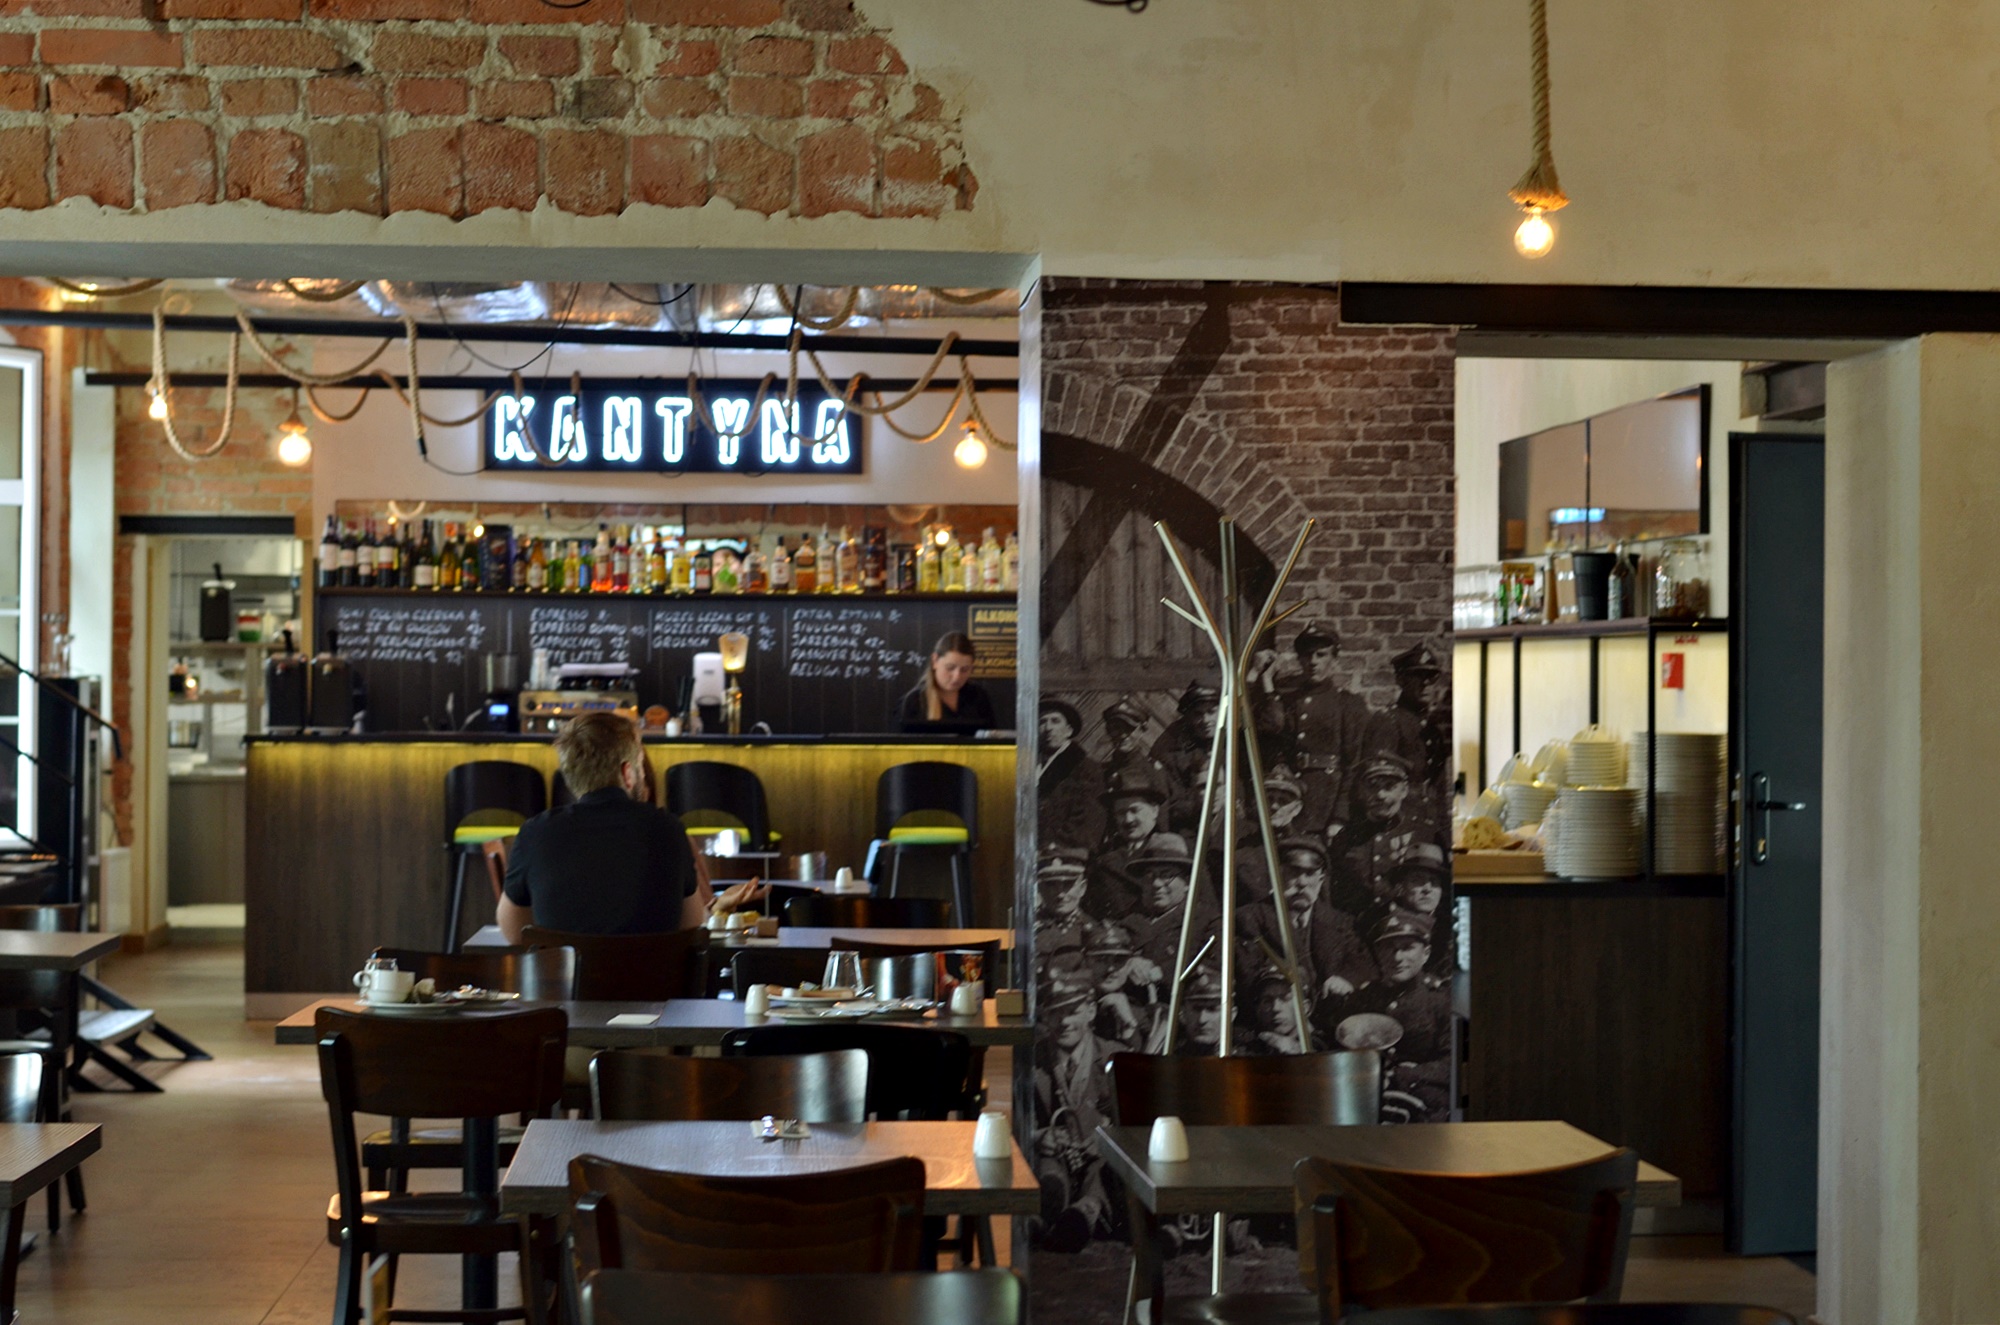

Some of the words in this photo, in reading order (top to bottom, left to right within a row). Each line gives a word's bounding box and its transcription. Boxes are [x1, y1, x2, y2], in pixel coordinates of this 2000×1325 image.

[495, 396, 851, 465] KANTYNA
[530, 607, 589, 621] ESPRESSO
[529, 621, 586, 634] ESPRESSO
[530, 635, 601, 650] CAPPUCCINO
